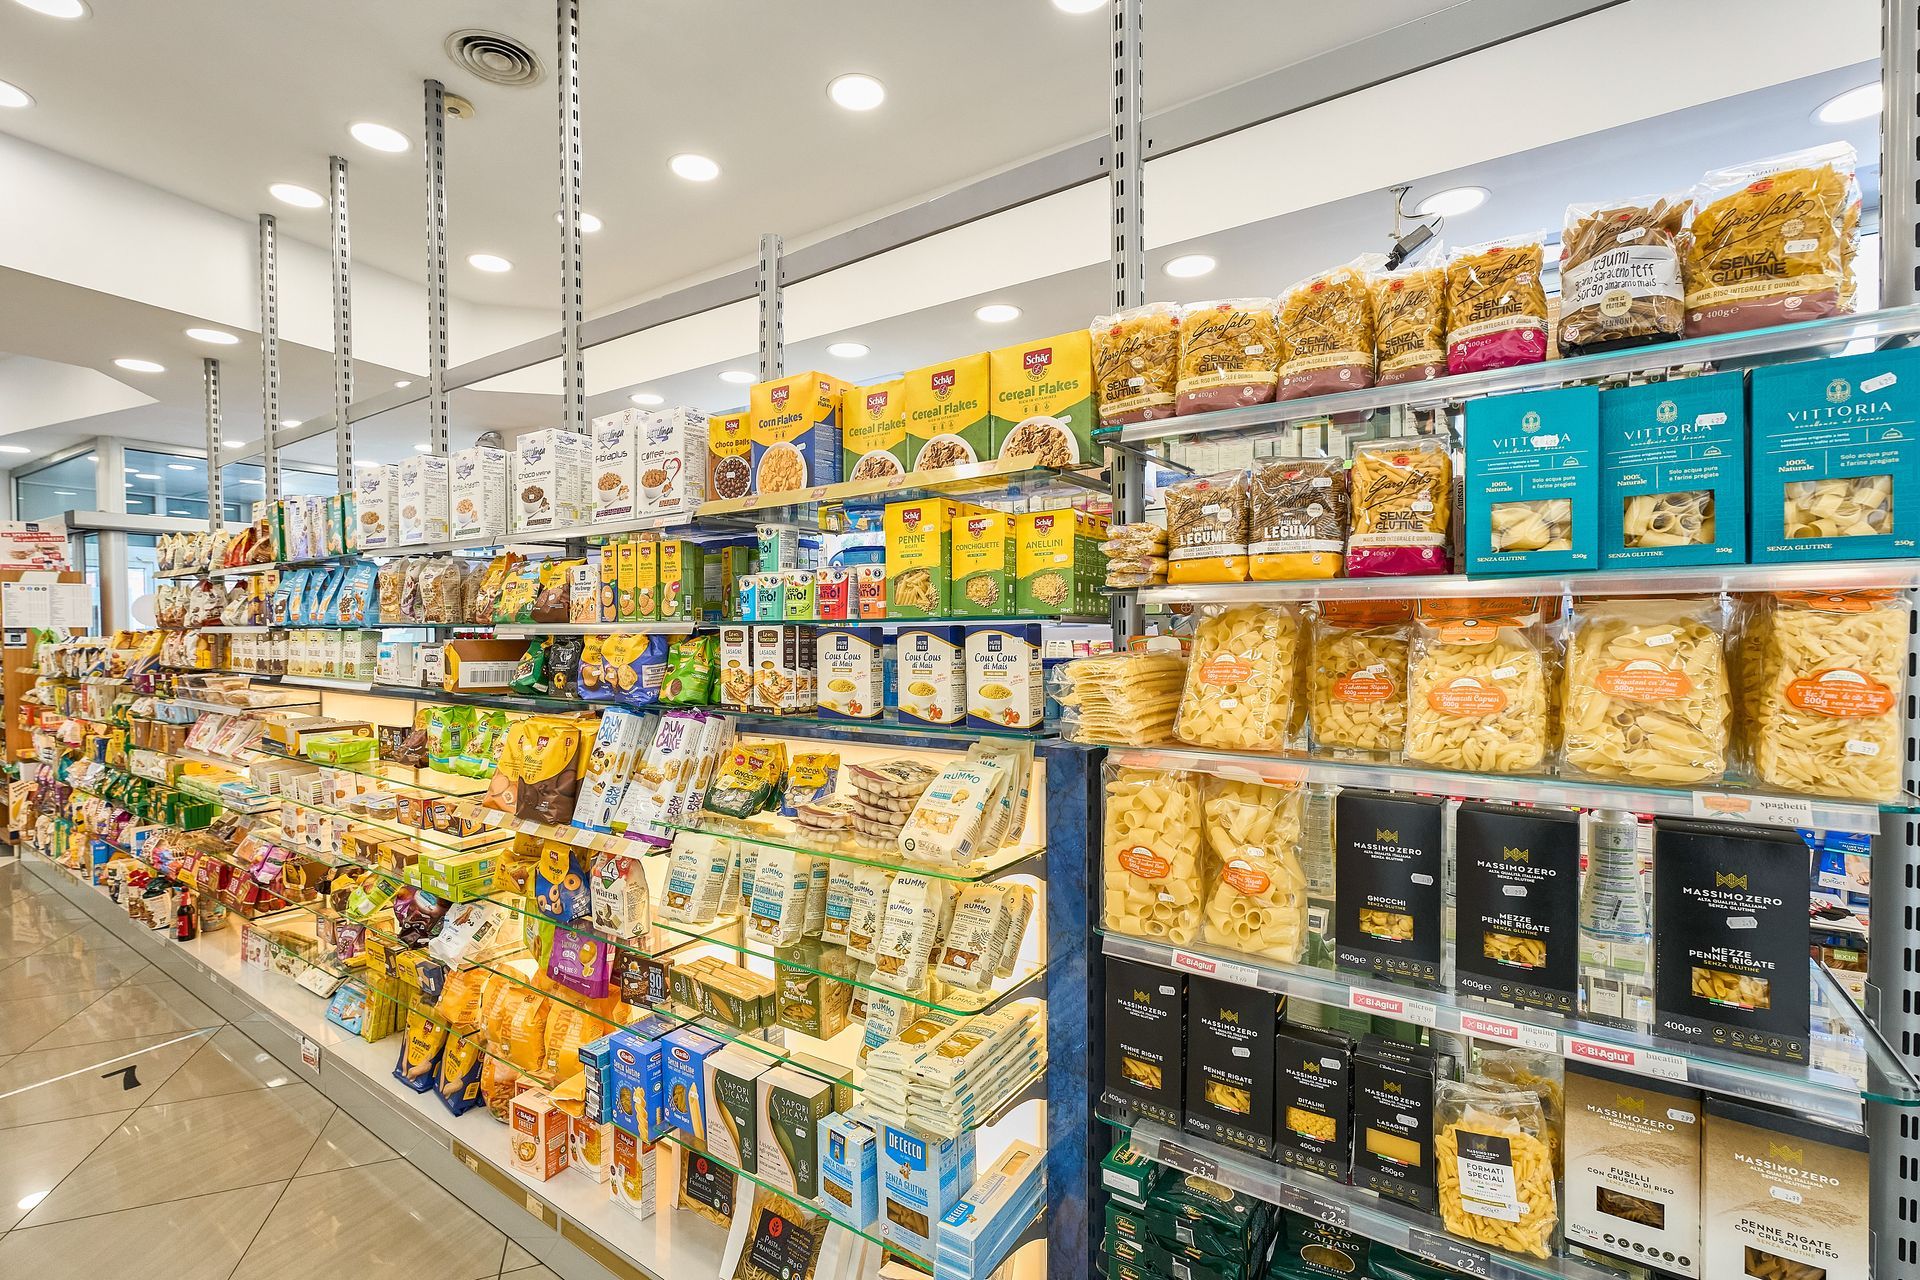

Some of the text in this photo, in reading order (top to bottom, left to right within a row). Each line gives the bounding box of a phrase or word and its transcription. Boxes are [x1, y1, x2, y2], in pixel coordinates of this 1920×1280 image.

[1720, 252, 1778, 271] SENZA
[1630, 264, 1654, 278] teff
[1711, 262, 1787, 283] GLUTINE
[1638, 278, 1657, 287] mais
[1713, 289, 1729, 297] RISO
[1730, 285, 1767, 294] INTEGRALE
[1469, 302, 1523, 321] GLUTINE
[1300, 335, 1335, 346] SENZA
[1385, 332, 1418, 348] SENZA
[998, 378, 1079, 403] Cereal Flakes
[912, 400, 978, 421] Cereal Flakes
[1787, 401, 1892, 422] VITTORIA
[759, 412, 803, 429] Corn Flakes
[849, 417, 906, 437] Cereal Flakes
[1625, 422, 1712, 441] VITTORIA
[715, 438, 750, 449] Choco Balls
[1847, 459, 1868, 467] farine
[1869, 456, 1900, 466] pregiate
[1858, 452, 1880, 460] acqua
[1882, 450, 1899, 458] pura
[1778, 464, 1814, 473] Naturale
[1617, 479, 1648, 487] Naturale
[1180, 530, 1226, 545] LEGUMI
[1264, 525, 1315, 539] LEGUMI
[898, 534, 925, 545] PENNE
[1026, 539, 1063, 549] ANELLINI
[1894, 540, 1915, 548] 250g
[1795, 543, 1833, 551] GLUTINE
[824, 651, 861, 661] Cous Cous
[905, 652, 942, 662] Cous Cous
[974, 652, 1018, 663] Cous Cous
[1803, 697, 1828, 707] 500g
[598, 726, 619, 743] CAKE
[662, 720, 686, 736] PLUM
[656, 732, 682, 750] CAKE
[943, 772, 980, 784] RUMMO
[1760, 801, 1808, 813] spaghetti
[1777, 816, 1799, 824] 5.50
[678, 855, 697, 865] RUMMO
[1367, 895, 1406, 907] GNOCCHI
[1738, 902, 1767, 910] ITALIANA
[1481, 915, 1551, 933] PENNE RIGATE
[1499, 912, 1532, 924] MEZZE
[1711, 947, 1752, 958] MEZZE
[1689, 950, 1775, 970] PENNE RIGATE
[650, 972, 662, 990] 90
[783, 991, 813, 1005] Gluten Free
[1408, 1002, 1434, 1011] micron
[1418, 1016, 1432, 1024] 3.39
[412, 1036, 431, 1052] Savoiardi
[613, 1058, 640, 1078] Senza Glutine
[667, 1056, 695, 1076] Senza Glutine
[724, 1079, 750, 1096] SAPORI
[781, 1097, 809, 1115] SAPORI
[1298, 1097, 1325, 1109] DITALINI
[1376, 1119, 1409, 1132] LASAGNE
[1466, 1163, 1504, 1175] FORMATI
[1610, 1166, 1650, 1183] FUSILLI
[1467, 1171, 1505, 1183] SPECIALI
[1587, 1167, 1675, 1195] CON CRUSCA DI RISO
[1314, 1221, 1352, 1238] MAIS
[764, 1235, 779, 1250] PASTA
[1301, 1229, 1360, 1252] ITALIANO
[1734, 1223, 1839, 1259] CON CRUSCA DI RISO
[755, 1240, 783, 1261] FRANCESCA
[1457, 1259, 1464, 1268] €
